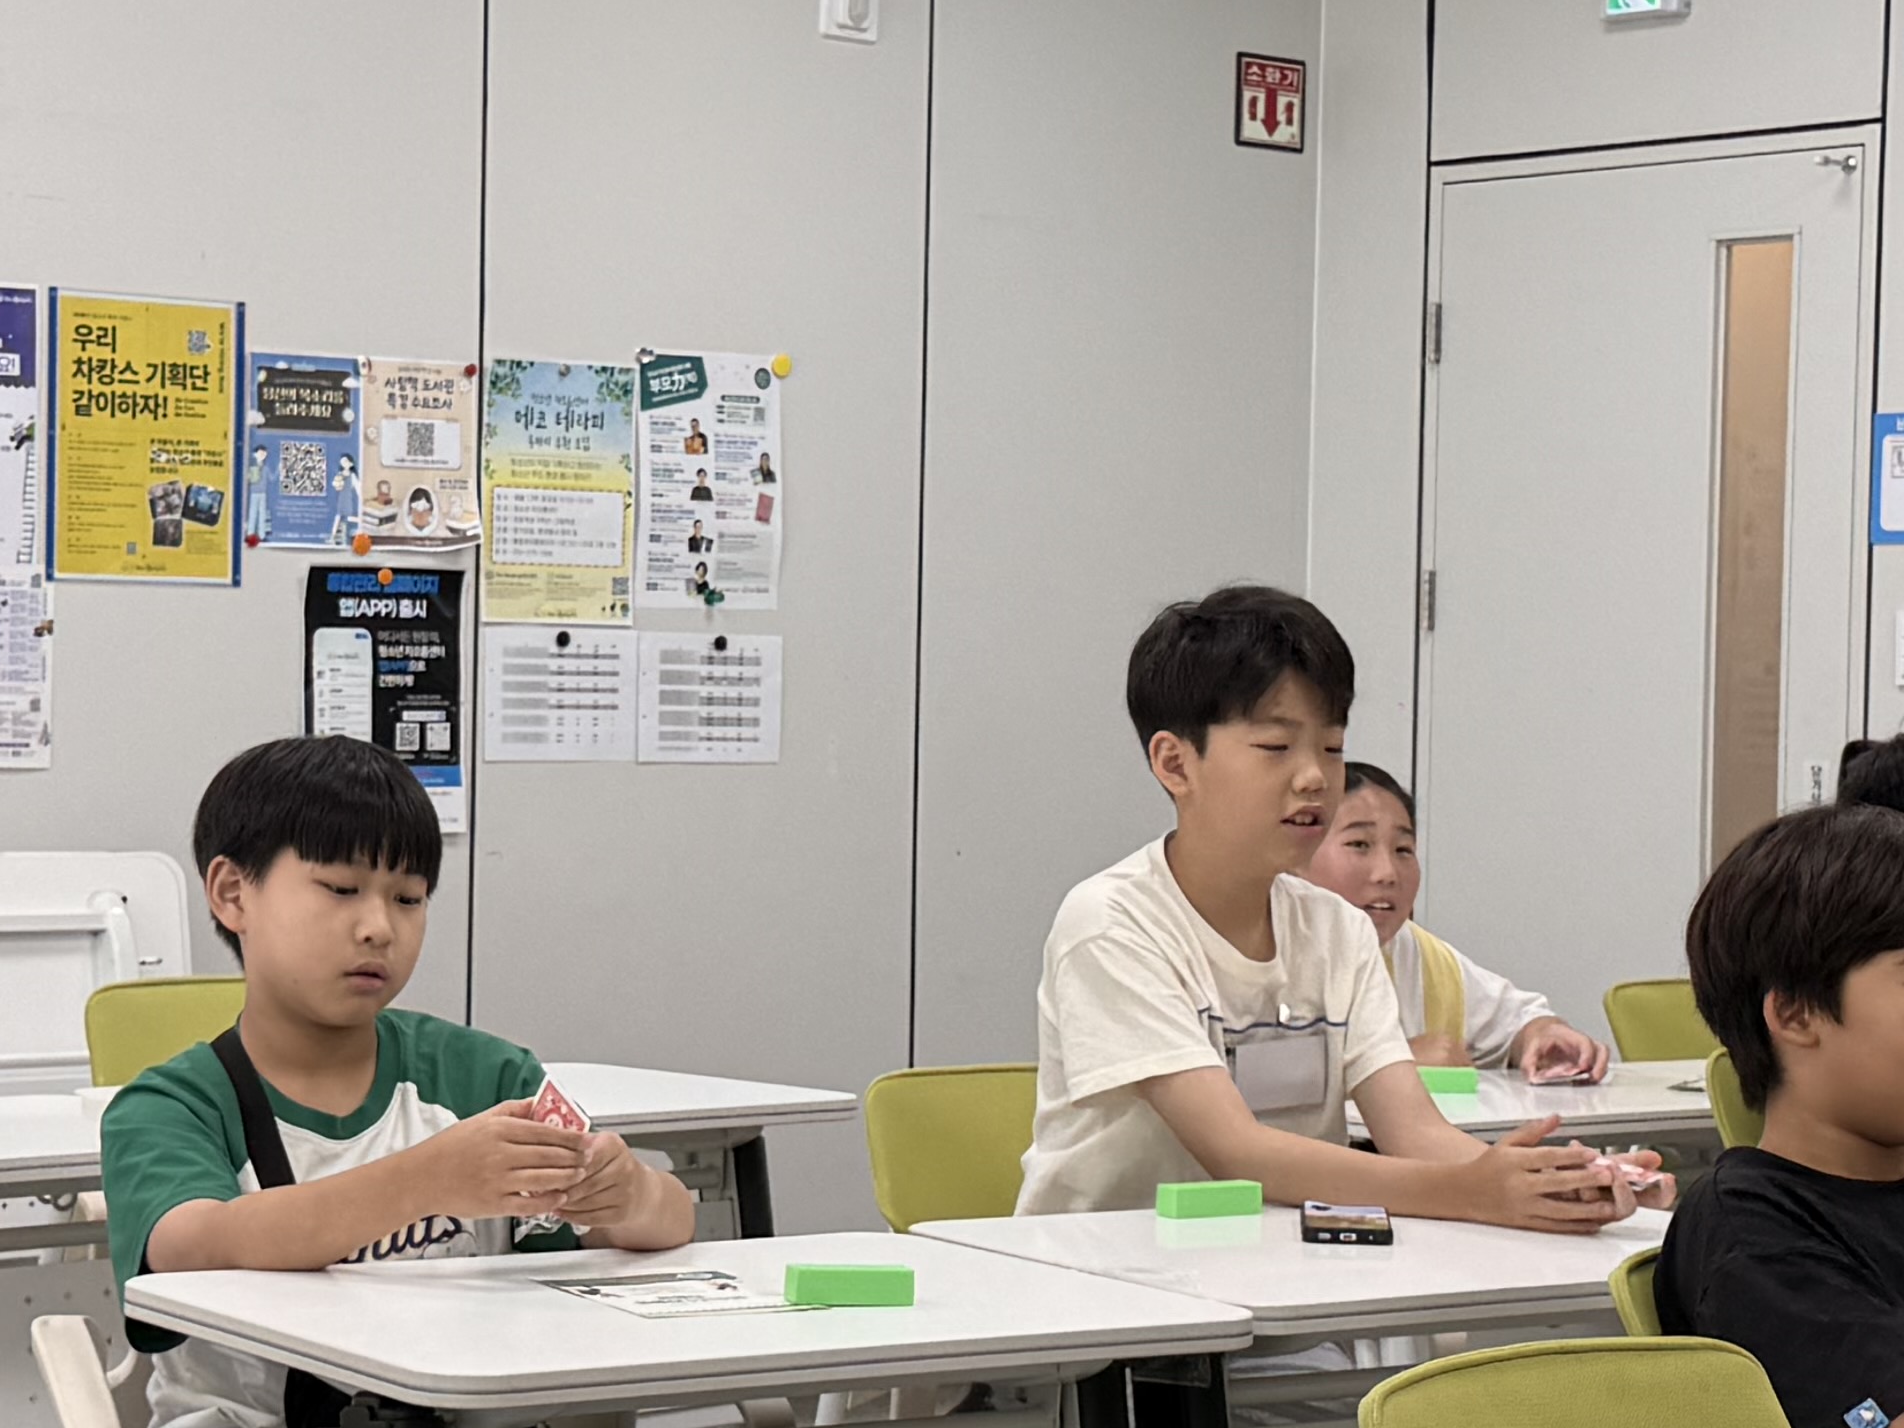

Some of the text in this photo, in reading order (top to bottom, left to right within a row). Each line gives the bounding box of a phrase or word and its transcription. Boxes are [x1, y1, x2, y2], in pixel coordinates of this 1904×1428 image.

[1246, 65, 1298, 87] 소화기
[72, 324, 117, 353] 우리
[71, 357, 211, 392] 차캉스 기획단
[71, 389, 168, 421] 같이하자!
[515, 405, 605, 432] 에코 테라피
[339, 597, 427, 619] 앱(APP) 출시
